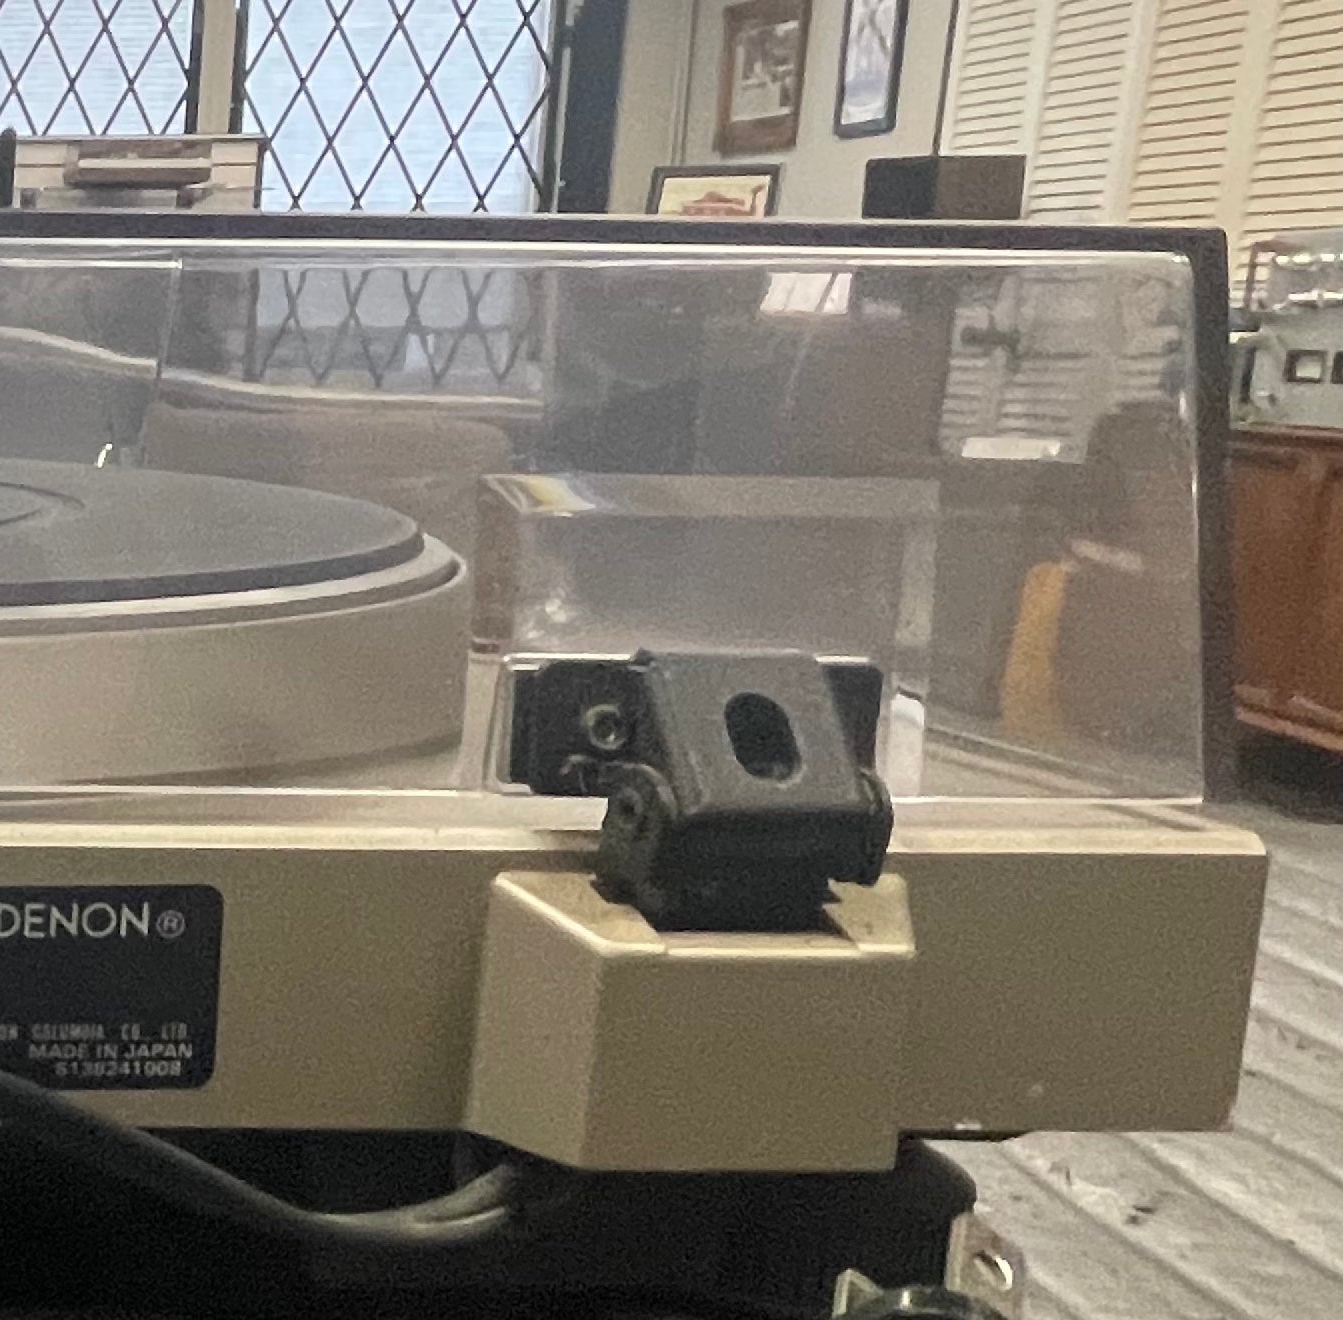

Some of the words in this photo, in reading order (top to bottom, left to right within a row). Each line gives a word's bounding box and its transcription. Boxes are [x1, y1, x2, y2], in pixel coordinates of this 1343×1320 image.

[28, 1043, 90, 1060] MADE
[96, 1043, 118, 1060] IN
[124, 1043, 193, 1060] JAPAN
